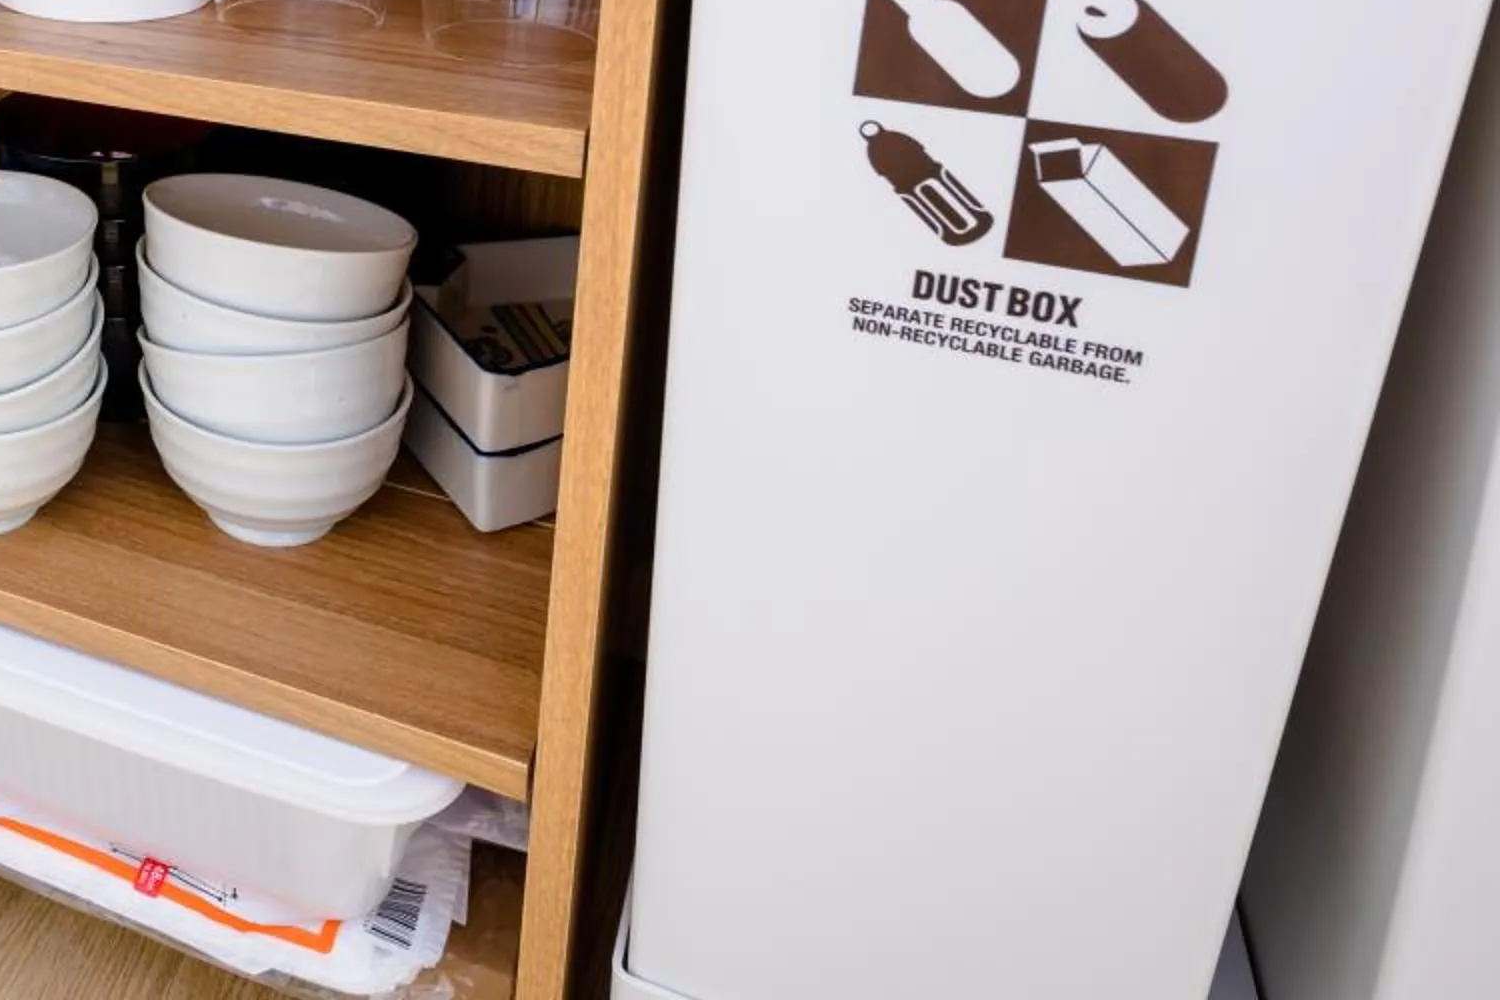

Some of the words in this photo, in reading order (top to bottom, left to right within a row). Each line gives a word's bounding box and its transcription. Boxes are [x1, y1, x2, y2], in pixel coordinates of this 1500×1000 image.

[848, 297, 945, 329] SEPARATE
[950, 317, 1077, 354] RECYCLABLE
[1083, 341, 1144, 366] FROM
[912, 269, 1004, 313] DUST
[1006, 286, 1083, 328] BOX
[852, 316, 1023, 363] NON-RECYCLABLE
[1029, 351, 1131, 385] GARBAGE.
